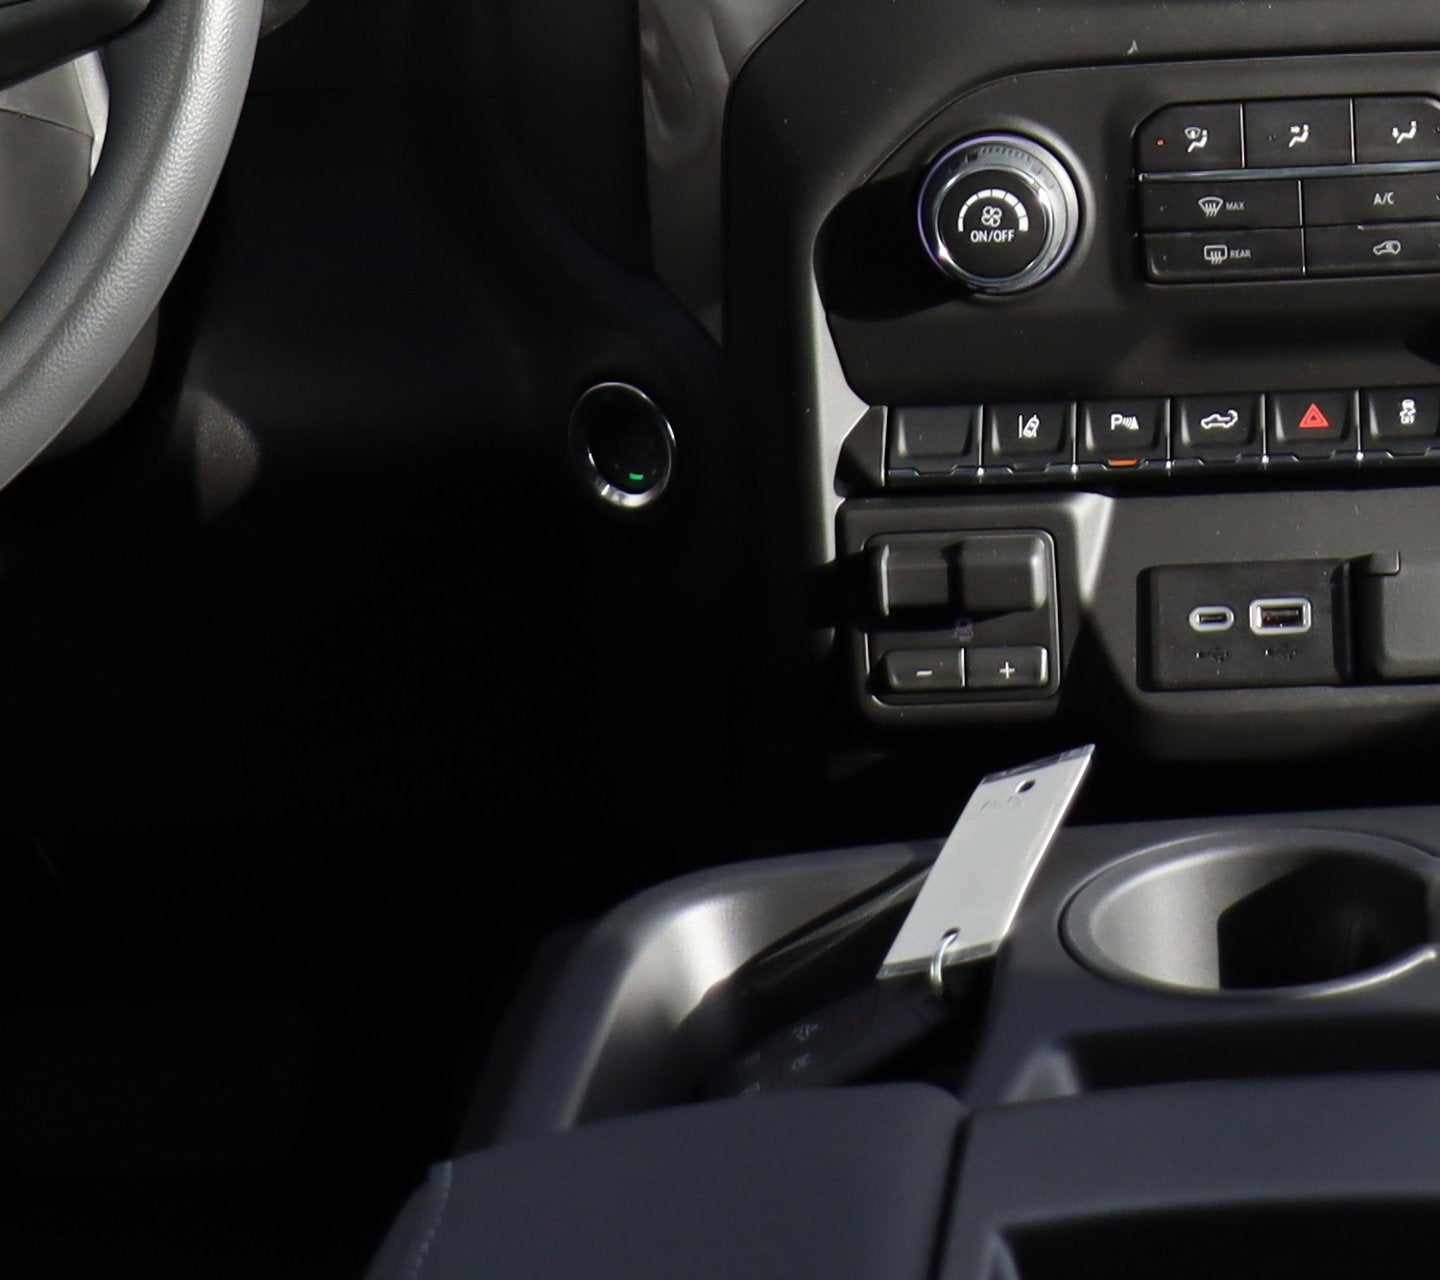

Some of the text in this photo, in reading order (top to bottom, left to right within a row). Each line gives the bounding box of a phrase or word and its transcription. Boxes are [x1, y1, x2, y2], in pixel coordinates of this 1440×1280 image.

[1372, 191, 1395, 206] A/C
[1224, 200, 1245, 211] MAX
[969, 228, 1015, 244] ON/OFF
[1228, 248, 1251, 259] REAR
[1400, 414, 1416, 425] OFF
